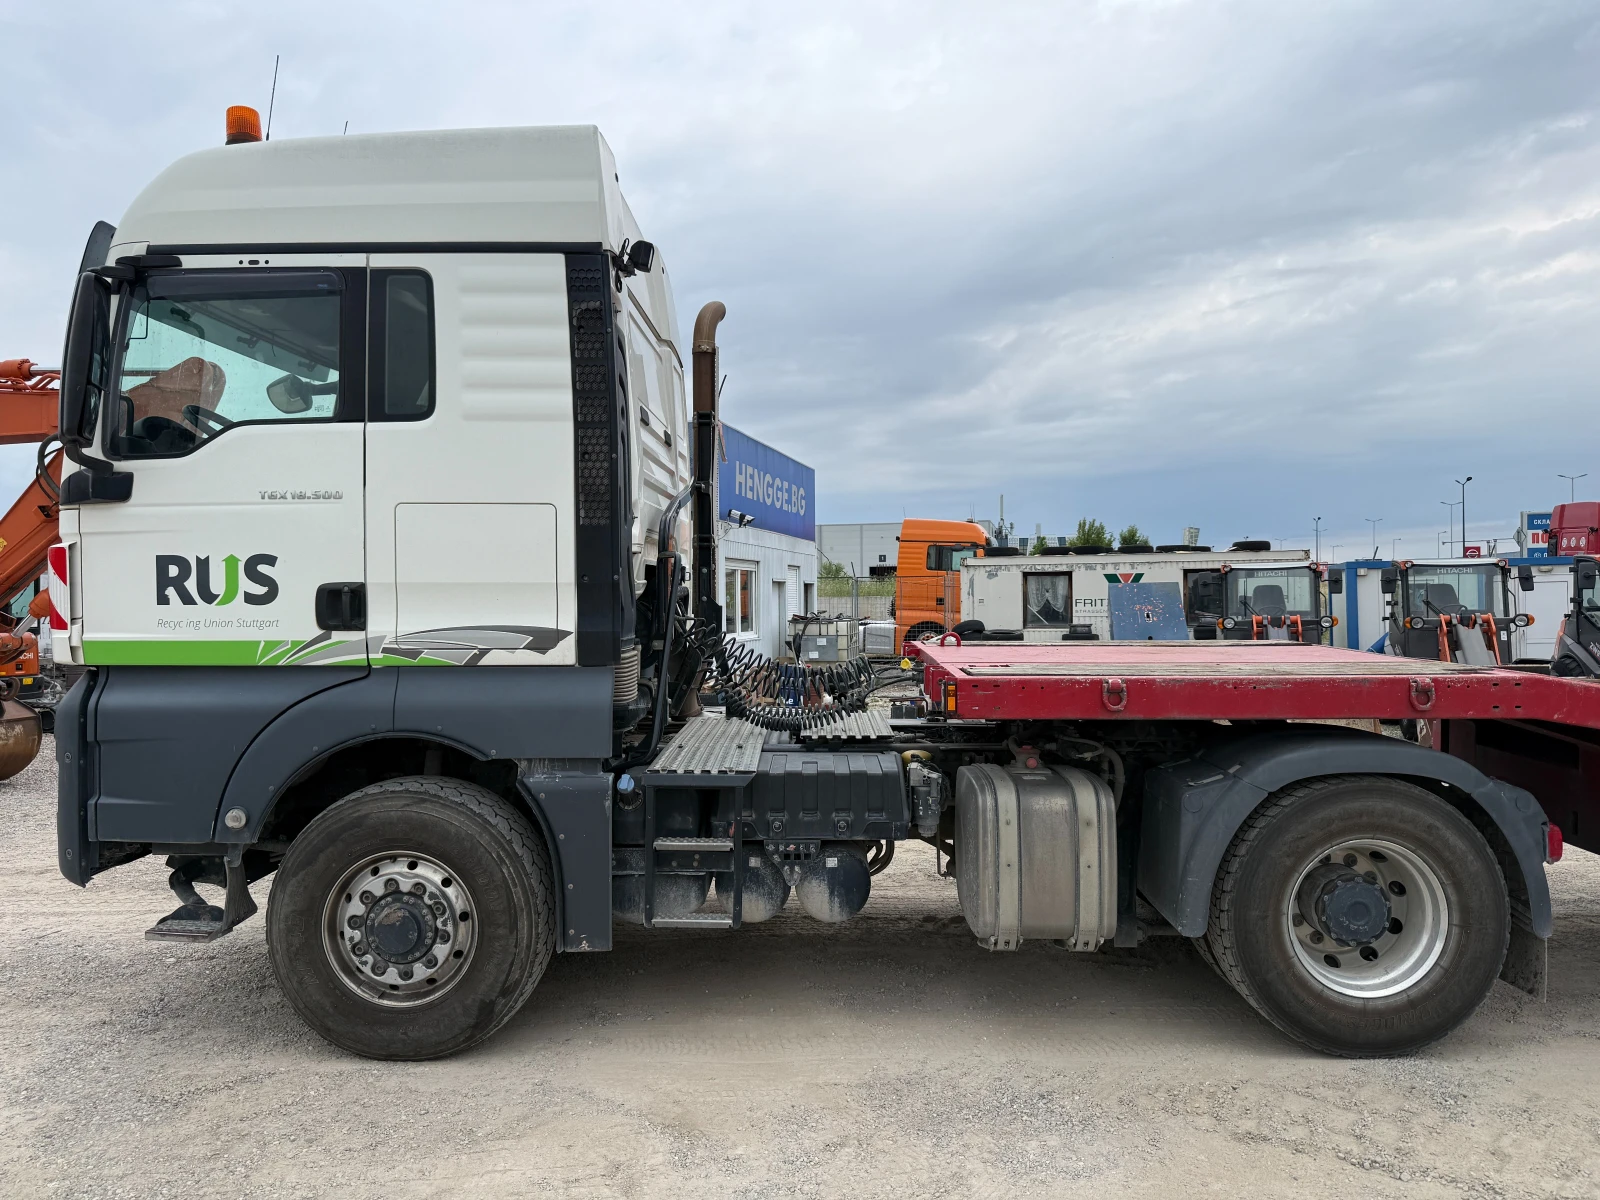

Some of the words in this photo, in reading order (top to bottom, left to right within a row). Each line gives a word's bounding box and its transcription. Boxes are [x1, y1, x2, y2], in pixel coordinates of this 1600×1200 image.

[735, 460, 806, 516] HENGGE.BG
[259, 490, 288, 500] TGX
[290, 490, 343, 500] 18.500
[155, 553, 279, 606] RUS
[1075, 598, 1108, 607] FRIT
[157, 618, 201, 630] Recycing
[203, 618, 233, 628] Union
[236, 617, 280, 630] Stuttgart
